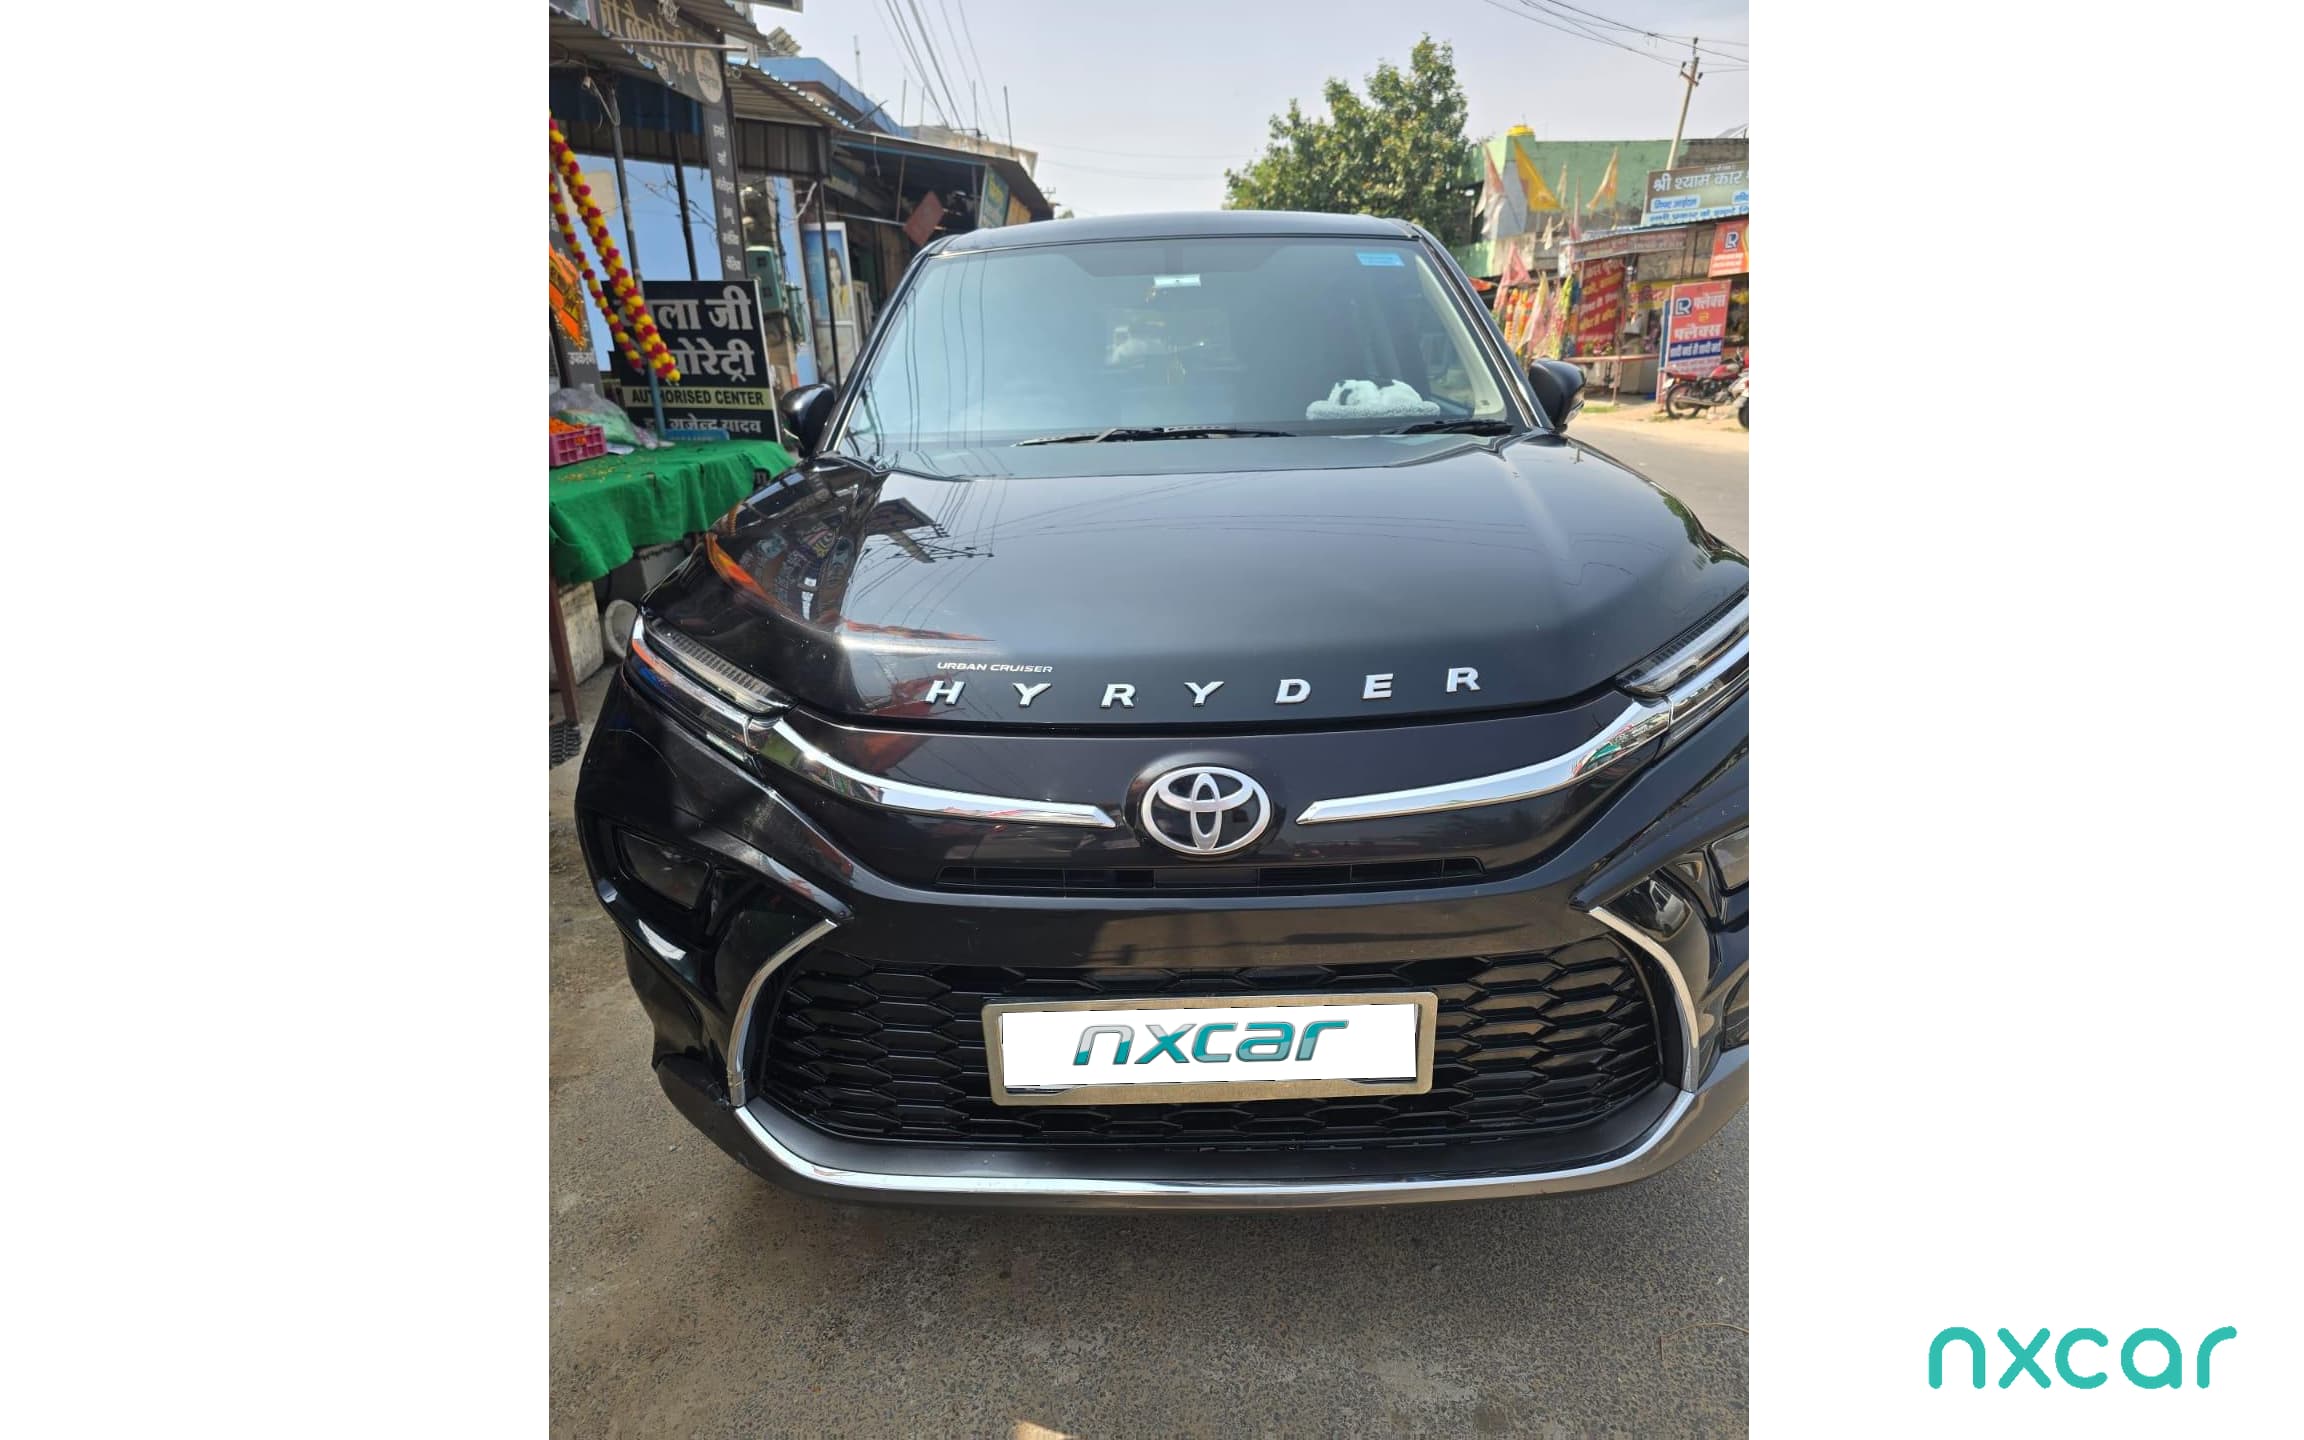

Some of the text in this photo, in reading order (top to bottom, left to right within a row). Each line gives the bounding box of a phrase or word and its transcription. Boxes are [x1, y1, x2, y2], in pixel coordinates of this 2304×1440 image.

[1653, 171, 1743, 192] श्री श्याम कार
[705, 285, 755, 331] जी
[715, 391, 764, 406] CENTER
[937, 662, 1053, 673] URBAN CRUISER
[925, 666, 1481, 708] HYRYDER
